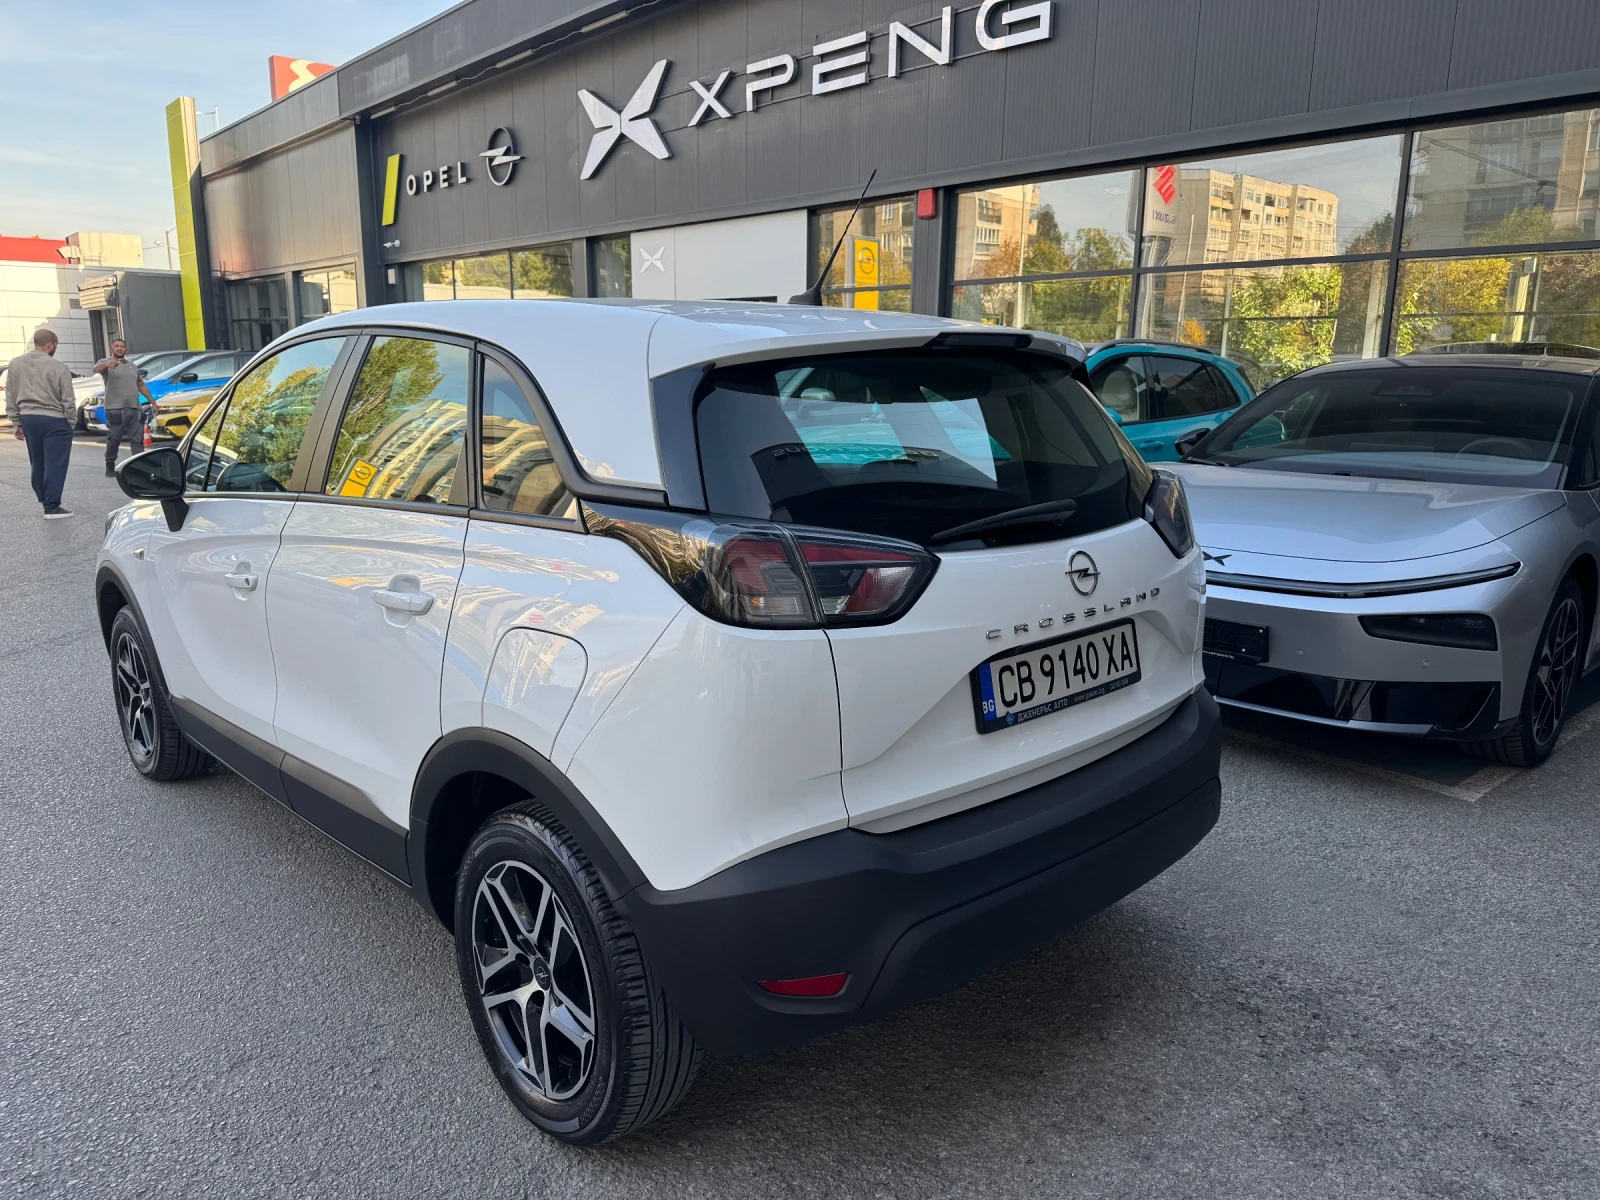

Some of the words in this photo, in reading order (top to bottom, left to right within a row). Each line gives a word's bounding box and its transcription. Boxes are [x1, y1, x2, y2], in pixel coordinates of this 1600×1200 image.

[688, 0, 1052, 127] XPENG
[406, 161, 467, 196] OPEL
[985, 587, 1161, 640] CROSSLAND
[998, 660, 1036, 708] CB
[1039, 641, 1100, 696] 9140
[1102, 632, 1134, 676] XA
[982, 699, 995, 714] BG
